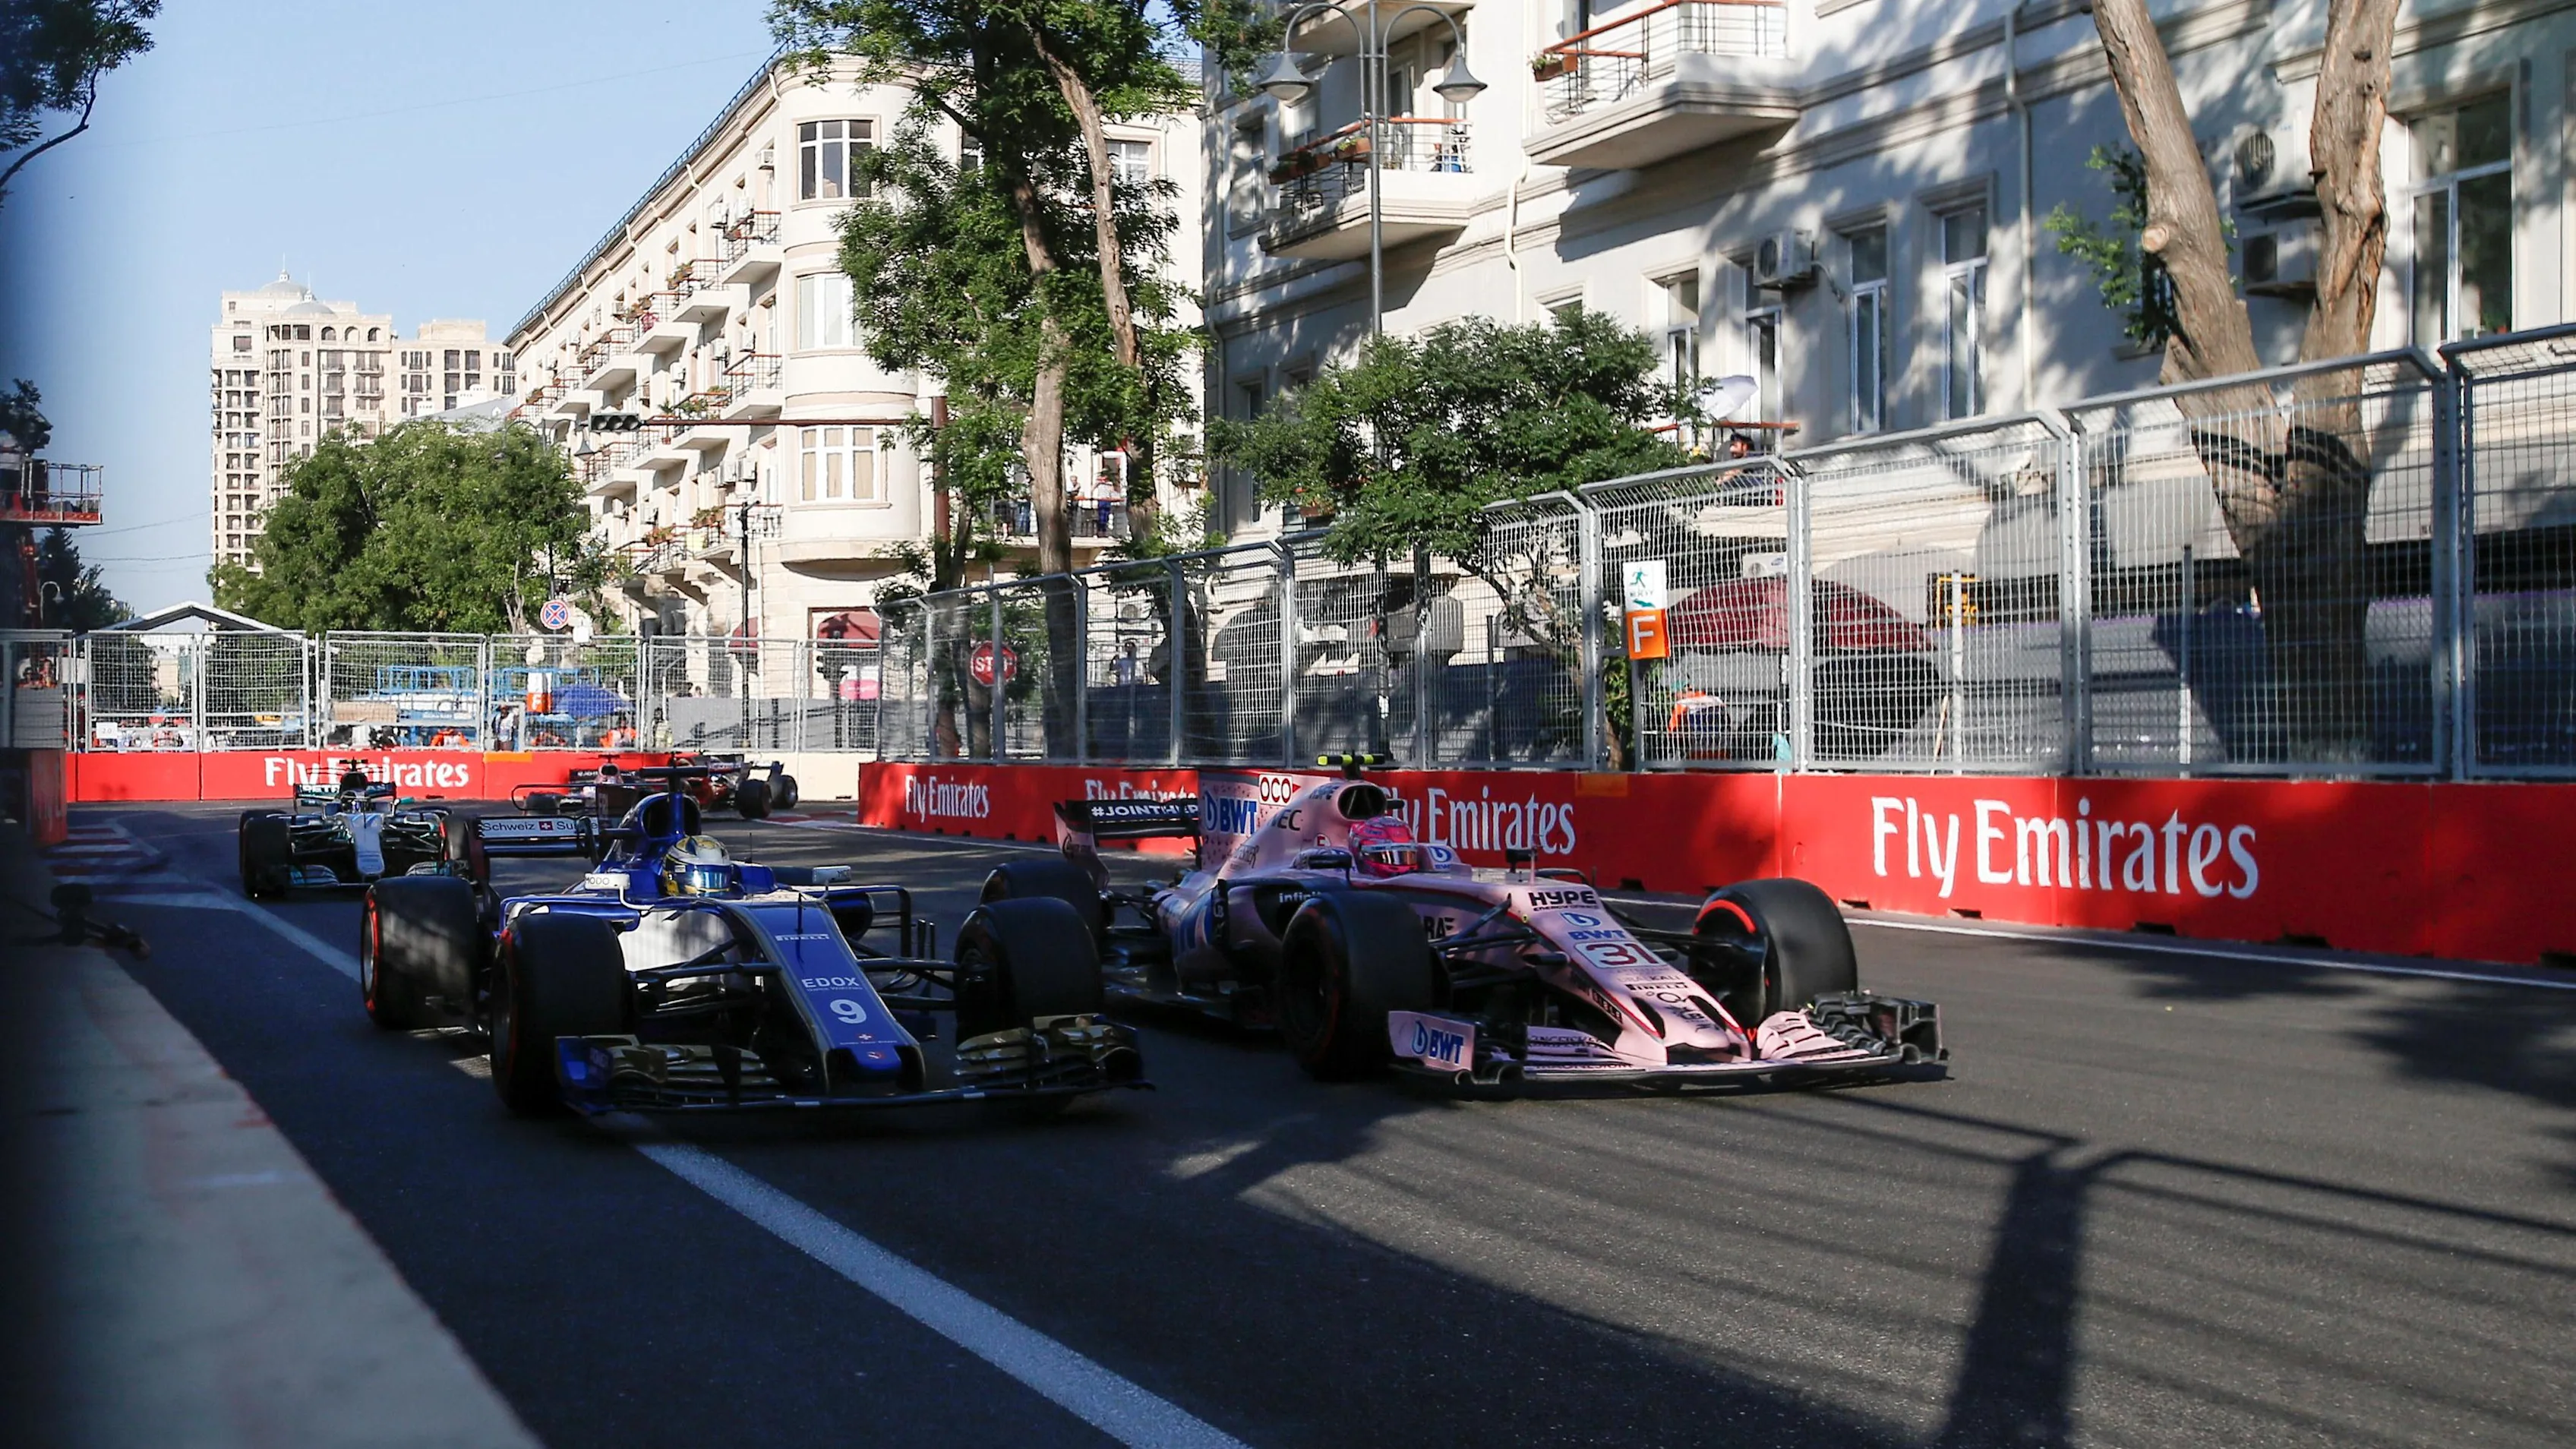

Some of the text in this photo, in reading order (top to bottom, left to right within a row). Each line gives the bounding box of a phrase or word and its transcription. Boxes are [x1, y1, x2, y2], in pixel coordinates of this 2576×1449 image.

[1632, 616, 1656, 653] F
[976, 655, 1013, 672] STP
[904, 775, 989, 823] Fly Emirates
[1260, 777, 1291, 803] OCO
[483, 822, 535, 831] Schweiz
[1220, 797, 1257, 835] BWT
[1428, 785, 1576, 855] Emirates
[1871, 796, 2259, 899] Fly Emirates
[1528, 890, 1597, 906] HYPE
[1567, 930, 1627, 940] BWT
[1586, 942, 1659, 965] 31
[801, 977, 860, 988] EDOX
[830, 999, 867, 1024] 9
[1428, 1028, 1465, 1065] BWT
